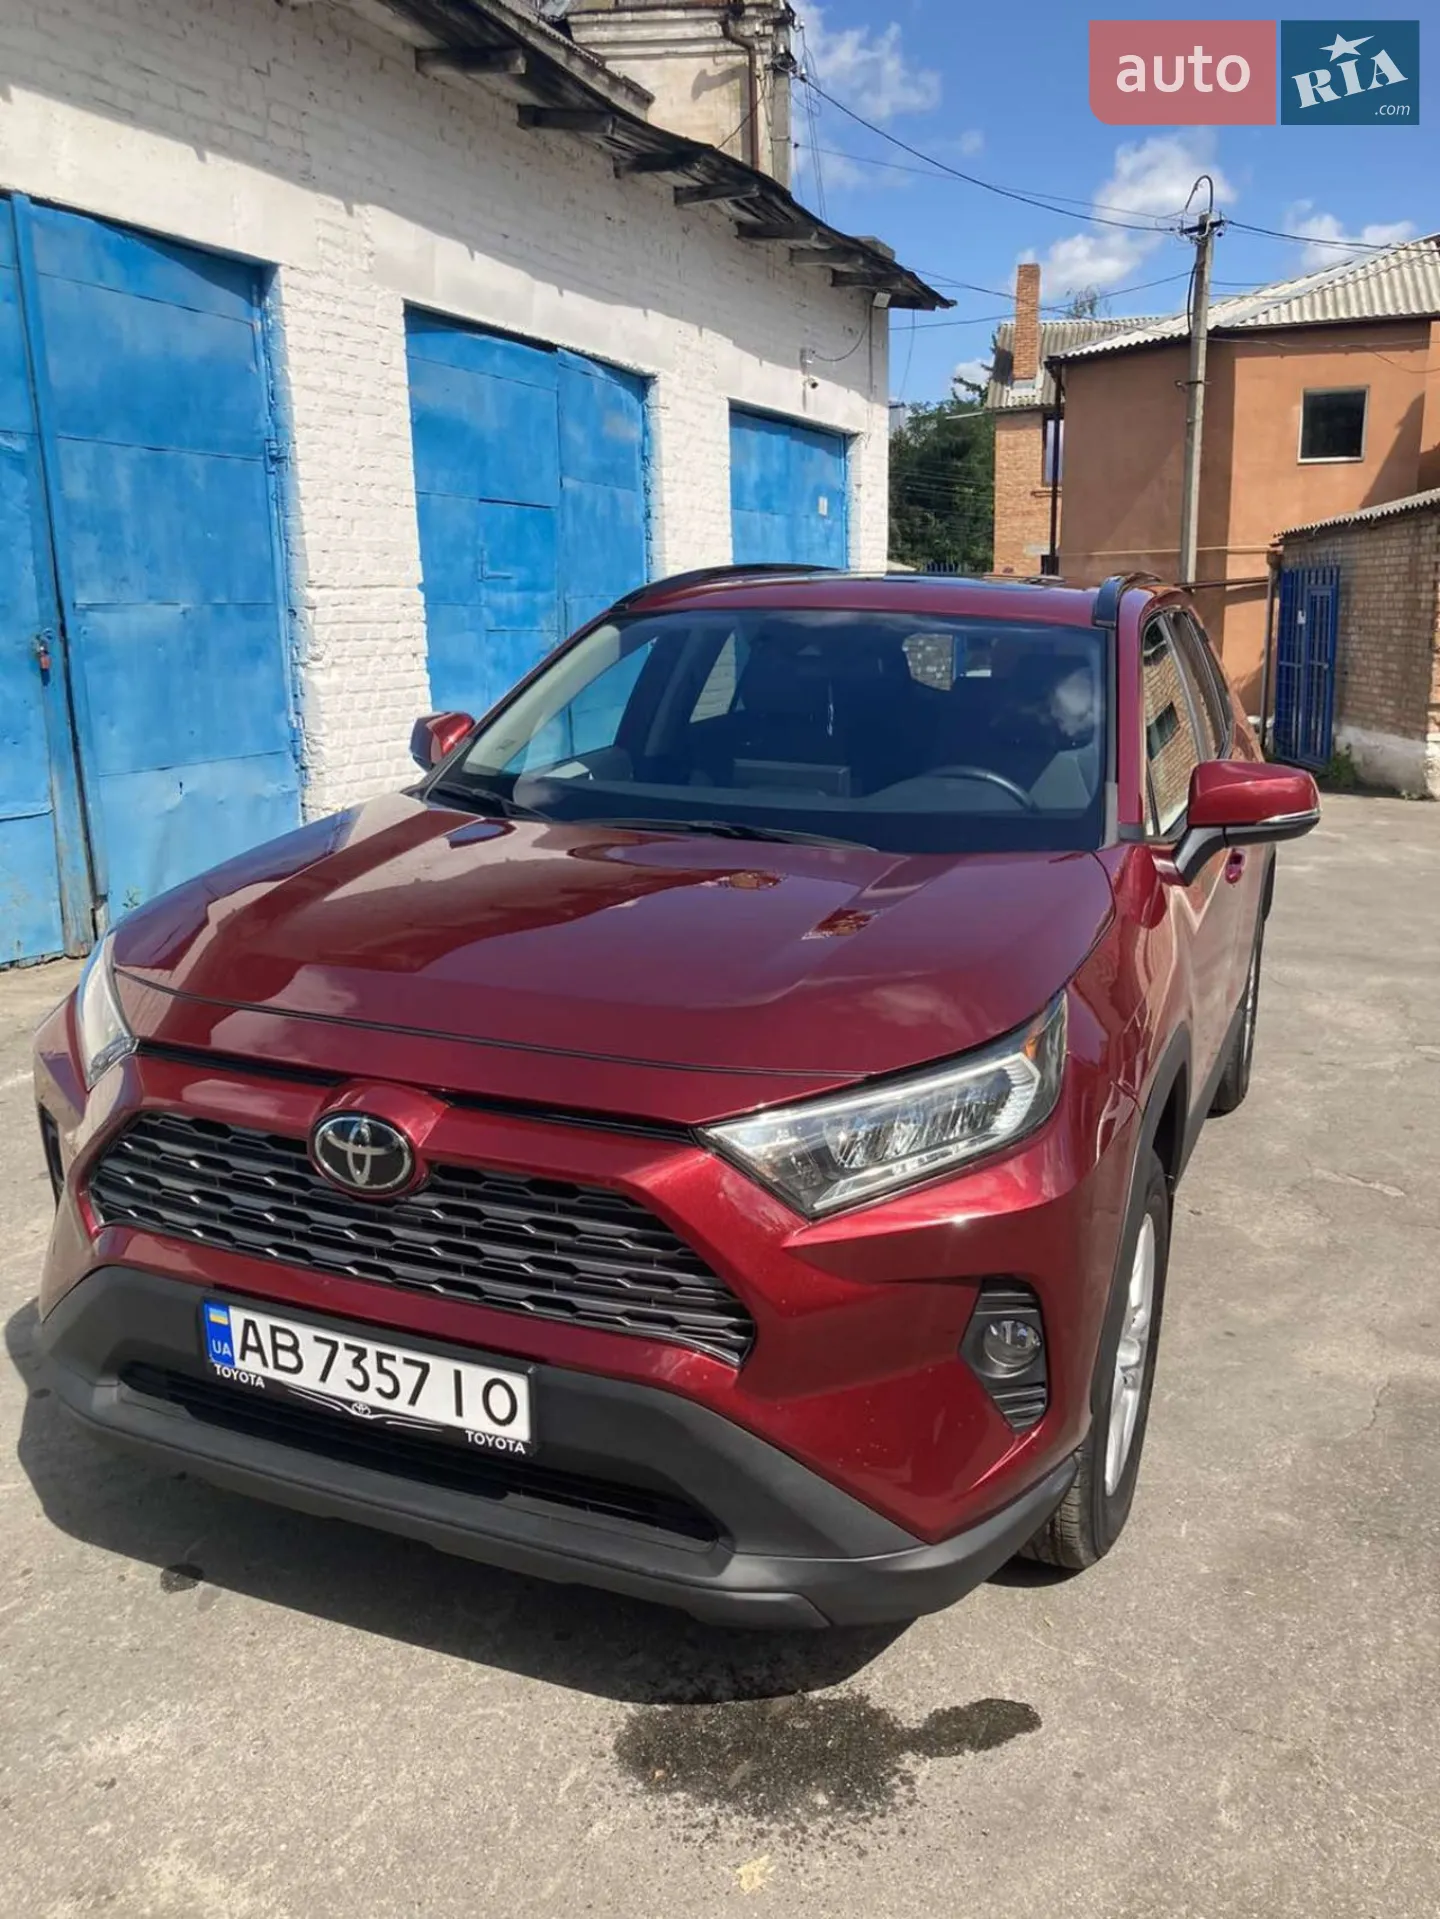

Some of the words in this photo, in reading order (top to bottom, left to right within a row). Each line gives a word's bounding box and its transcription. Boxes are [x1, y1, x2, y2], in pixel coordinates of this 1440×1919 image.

[211, 1339, 232, 1358] UA
[238, 1318, 304, 1375] AB
[313, 1335, 431, 1407] 7357
[213, 1364, 266, 1389] TOYOTA
[465, 1429, 527, 1455] TOYOTA
